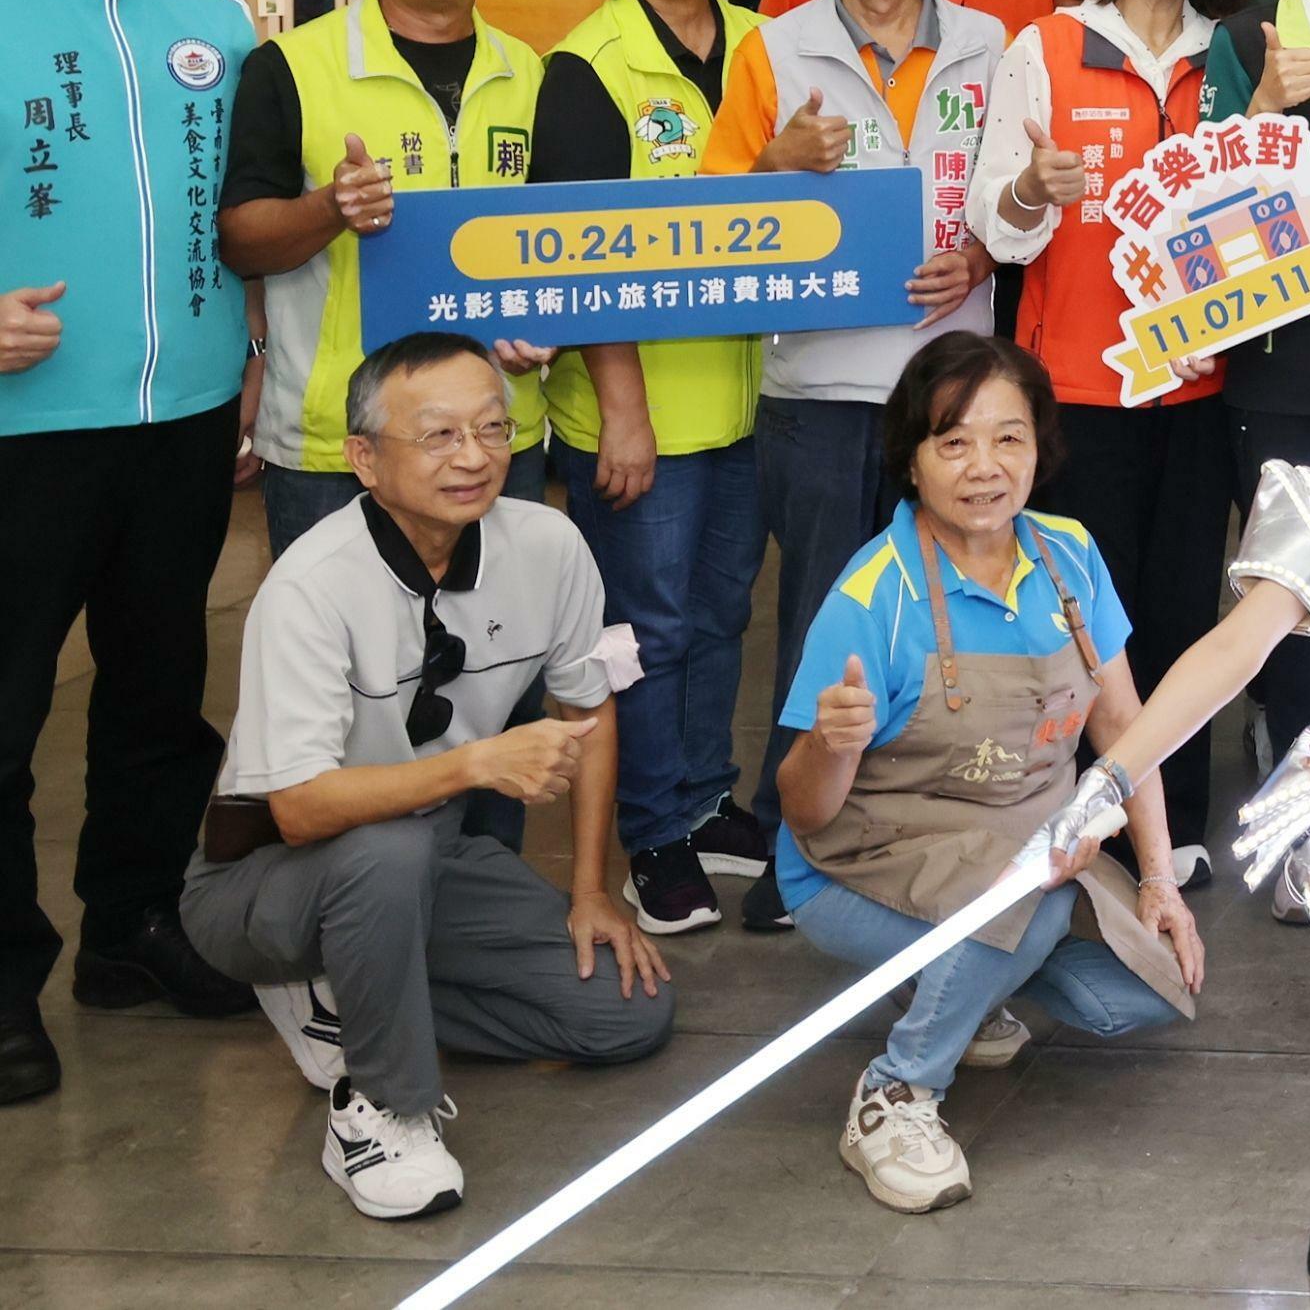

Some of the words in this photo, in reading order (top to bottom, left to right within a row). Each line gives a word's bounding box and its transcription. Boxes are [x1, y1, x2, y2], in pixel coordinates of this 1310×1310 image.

[53, 50, 91, 142] 理事長
[400, 131, 425, 176] 秘書
[496, 139, 525, 178] 賴
[181, 102, 208, 318] 美食文化交流協會
[934, 151, 966, 250] 陳亭妃
[515, 222, 636, 264] 10.24
[667, 216, 782, 256] 11.22
[1148, 288, 1245, 354] 11.07
